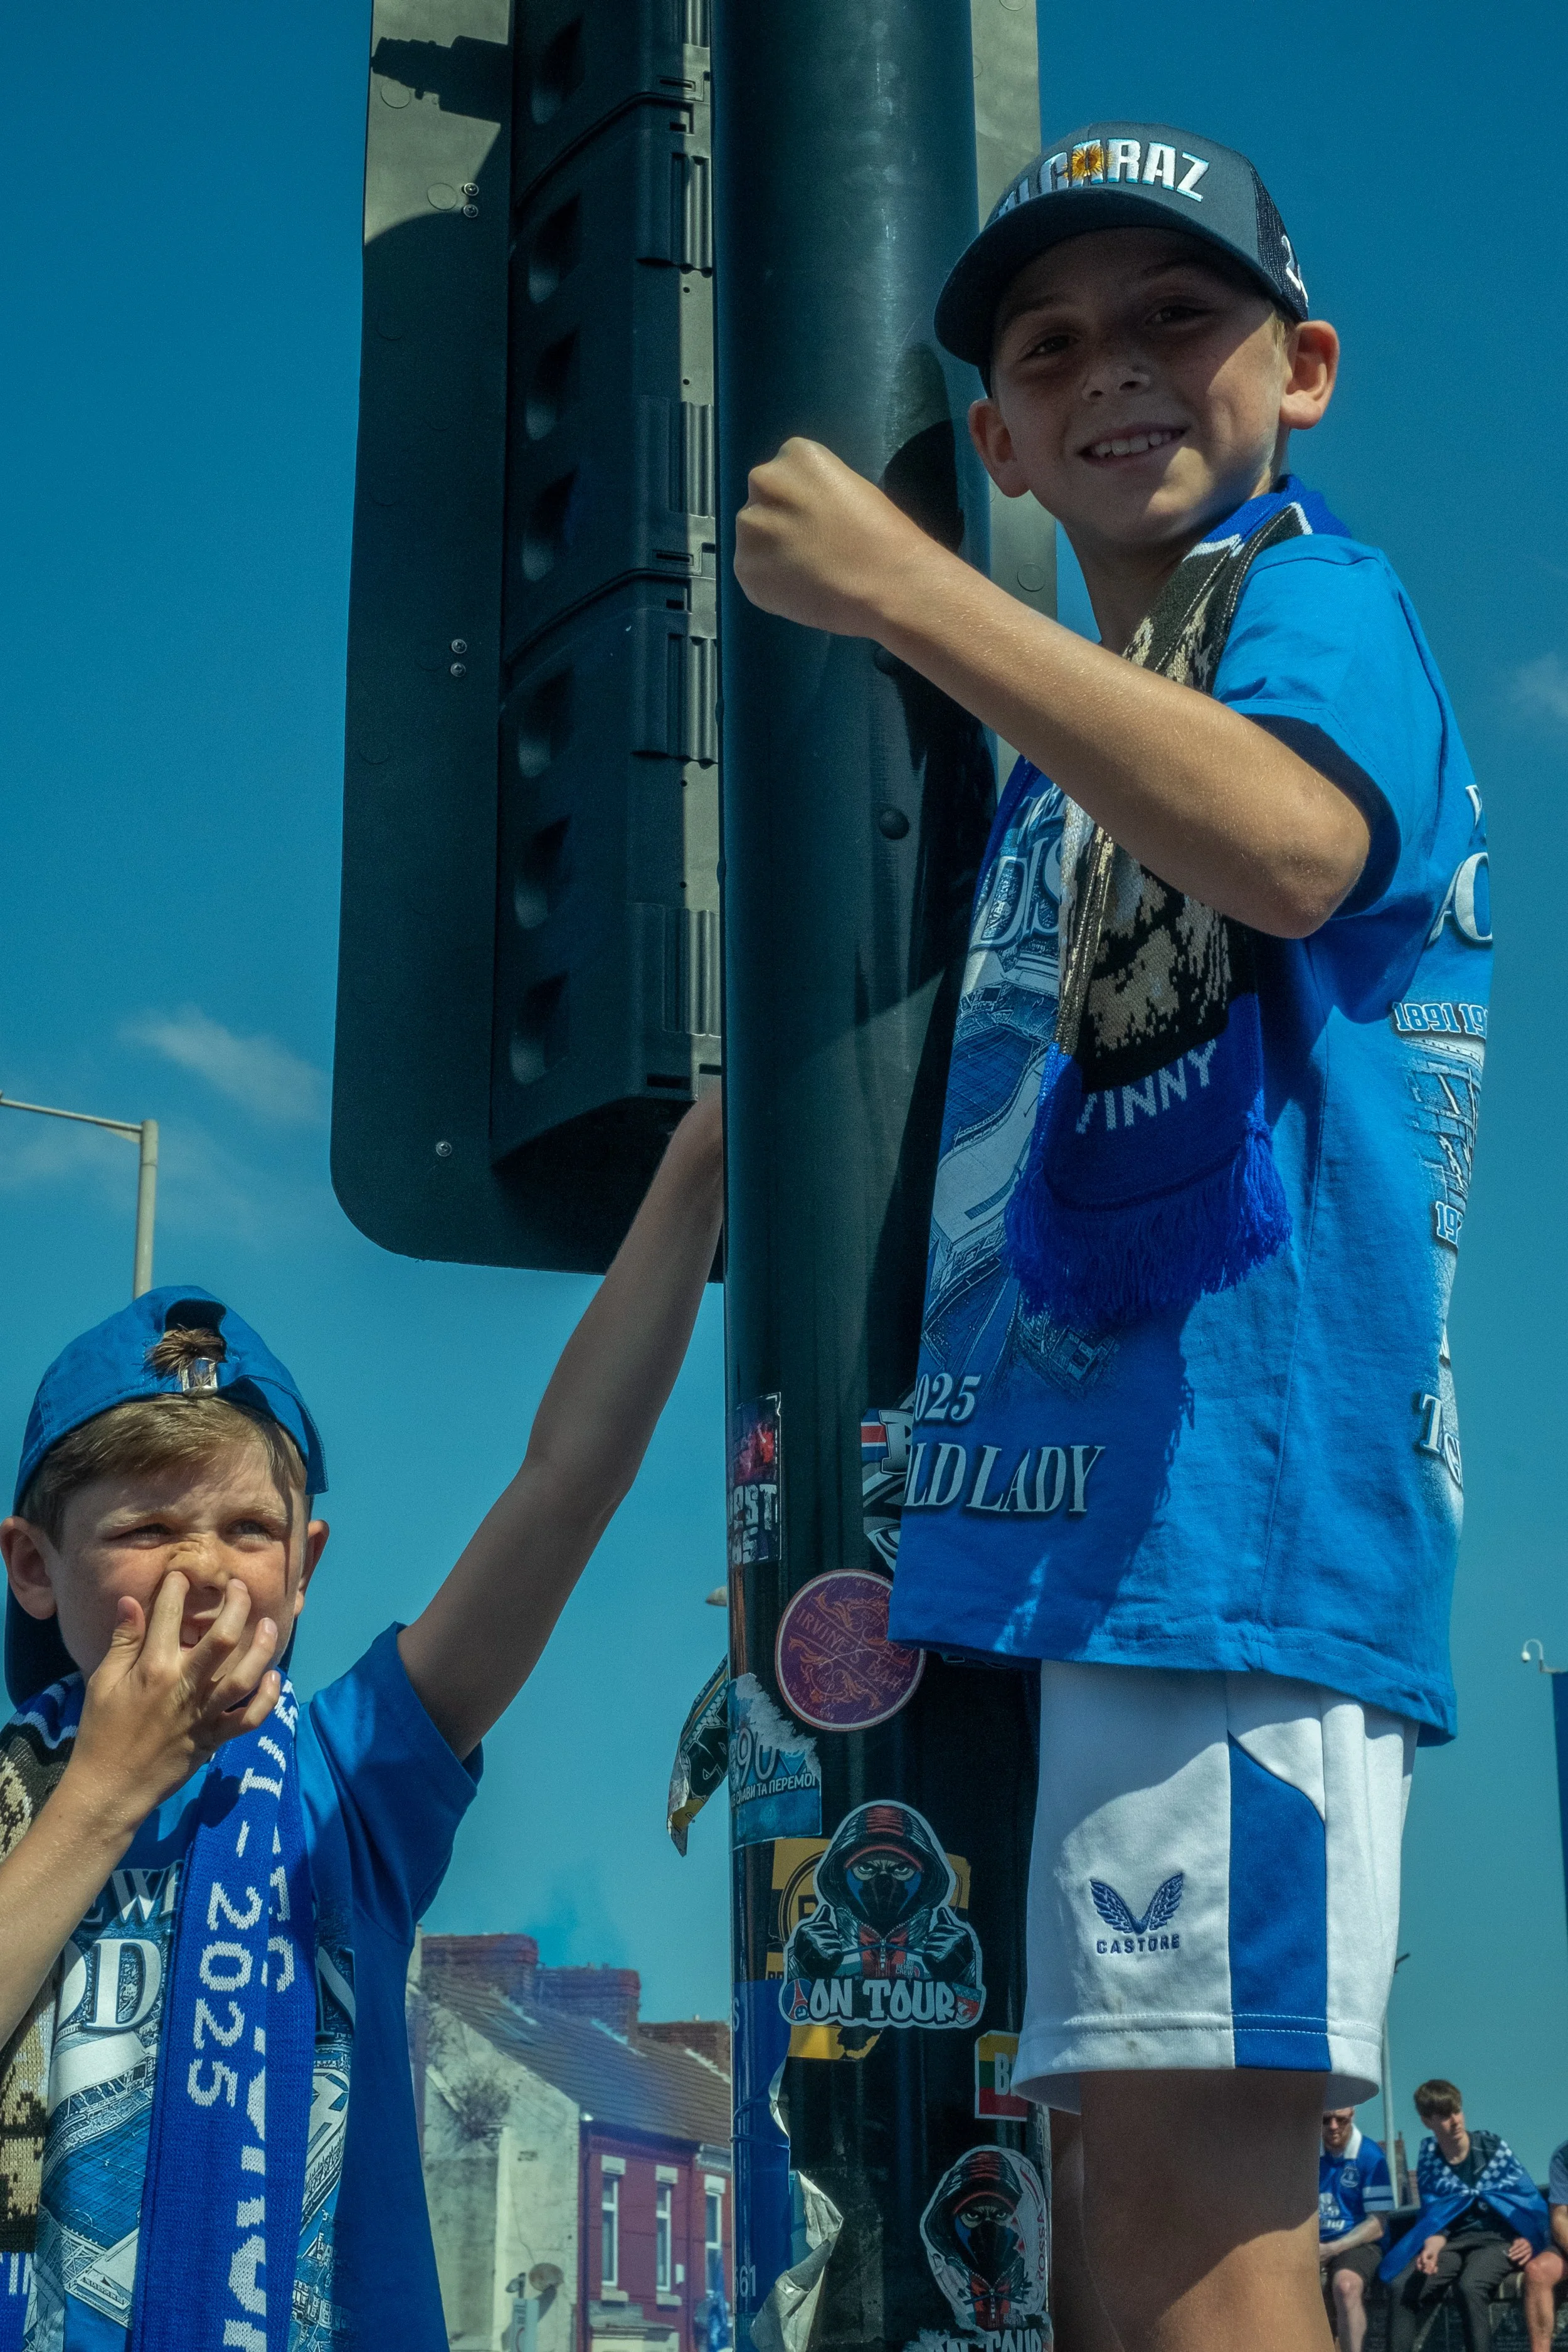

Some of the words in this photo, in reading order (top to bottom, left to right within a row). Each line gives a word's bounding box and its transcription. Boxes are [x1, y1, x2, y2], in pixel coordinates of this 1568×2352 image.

[1392, 1002, 1461, 1033] 1891
[913, 1372, 982, 1422] 025
[904, 1442, 967, 1507] LD
[966, 1444, 1106, 1513] LADY
[1096, 1934, 1180, 1955] CASTORE
[188, 1882, 263, 2107] 2025
[811, 1978, 853, 2020] ON
[863, 1978, 958, 2021] TOUR
